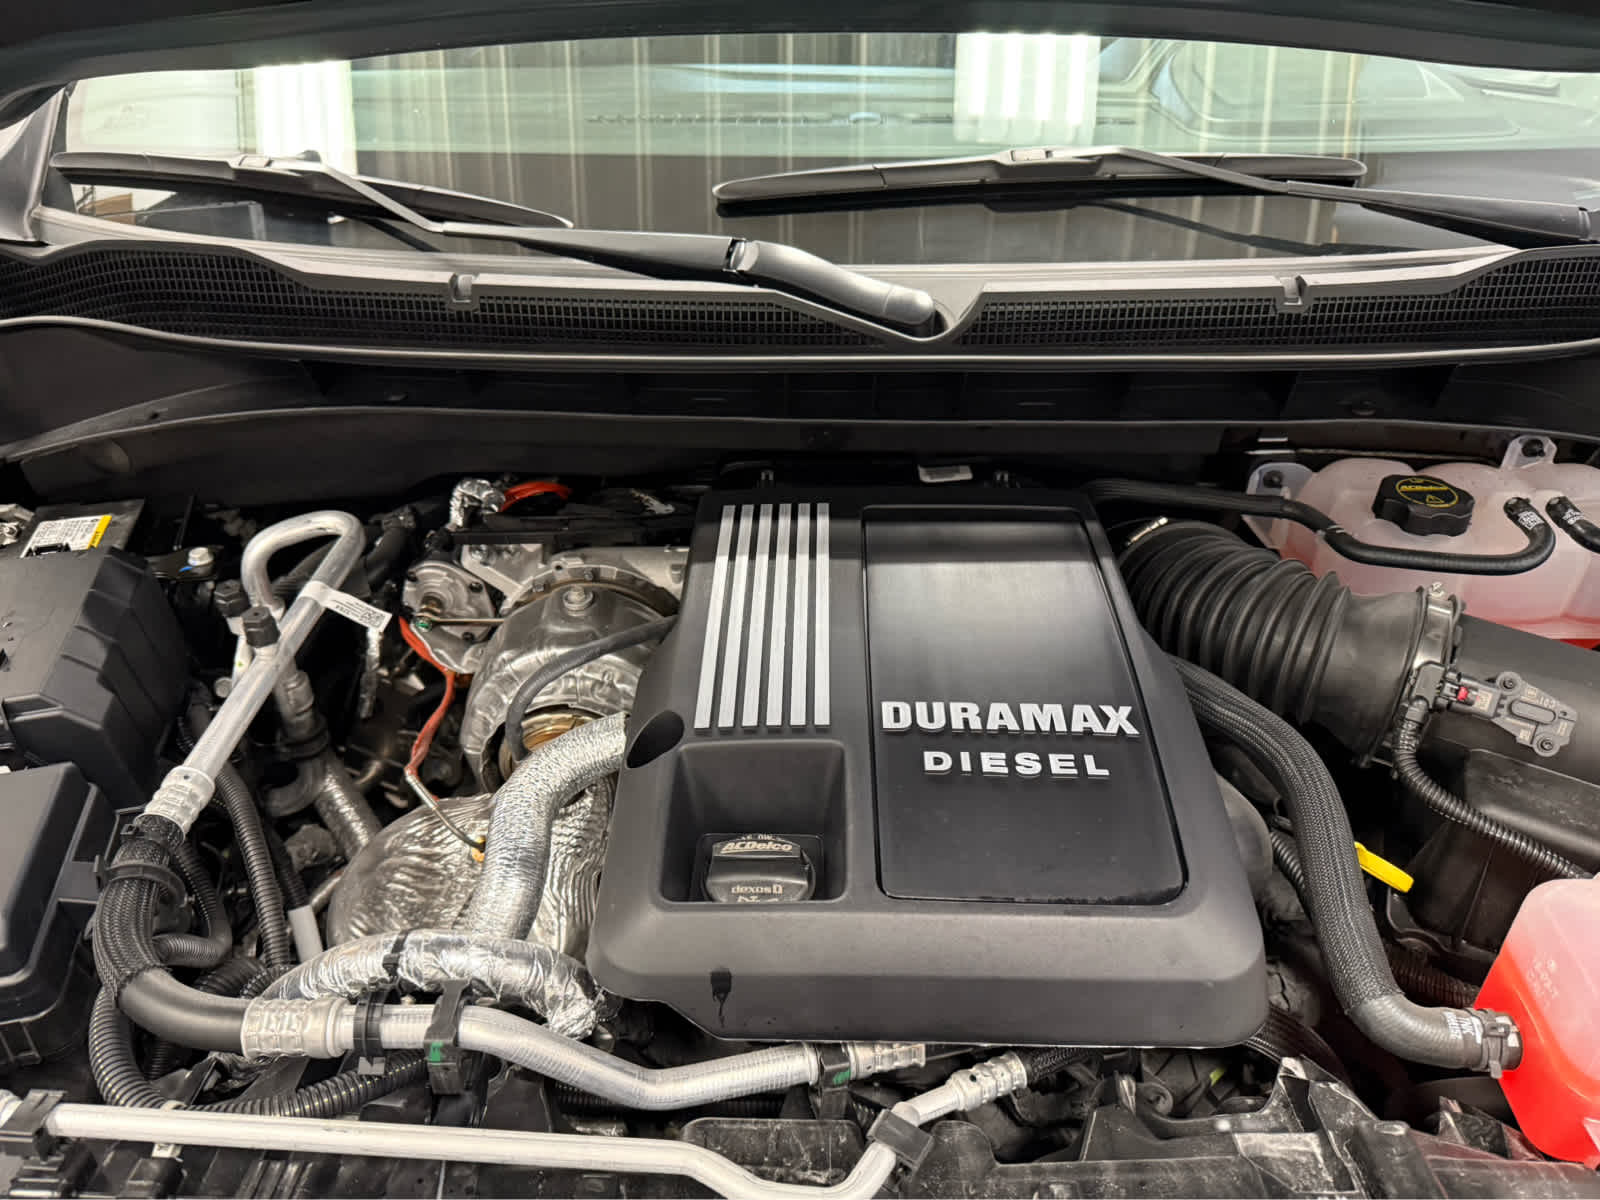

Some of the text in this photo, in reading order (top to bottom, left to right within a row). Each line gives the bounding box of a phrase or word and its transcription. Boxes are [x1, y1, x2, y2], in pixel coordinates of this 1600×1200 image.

[880, 700, 1141, 737] DURAMAX
[923, 751, 1111, 778] DIESEL
[720, 841, 793, 853] ACDelco
